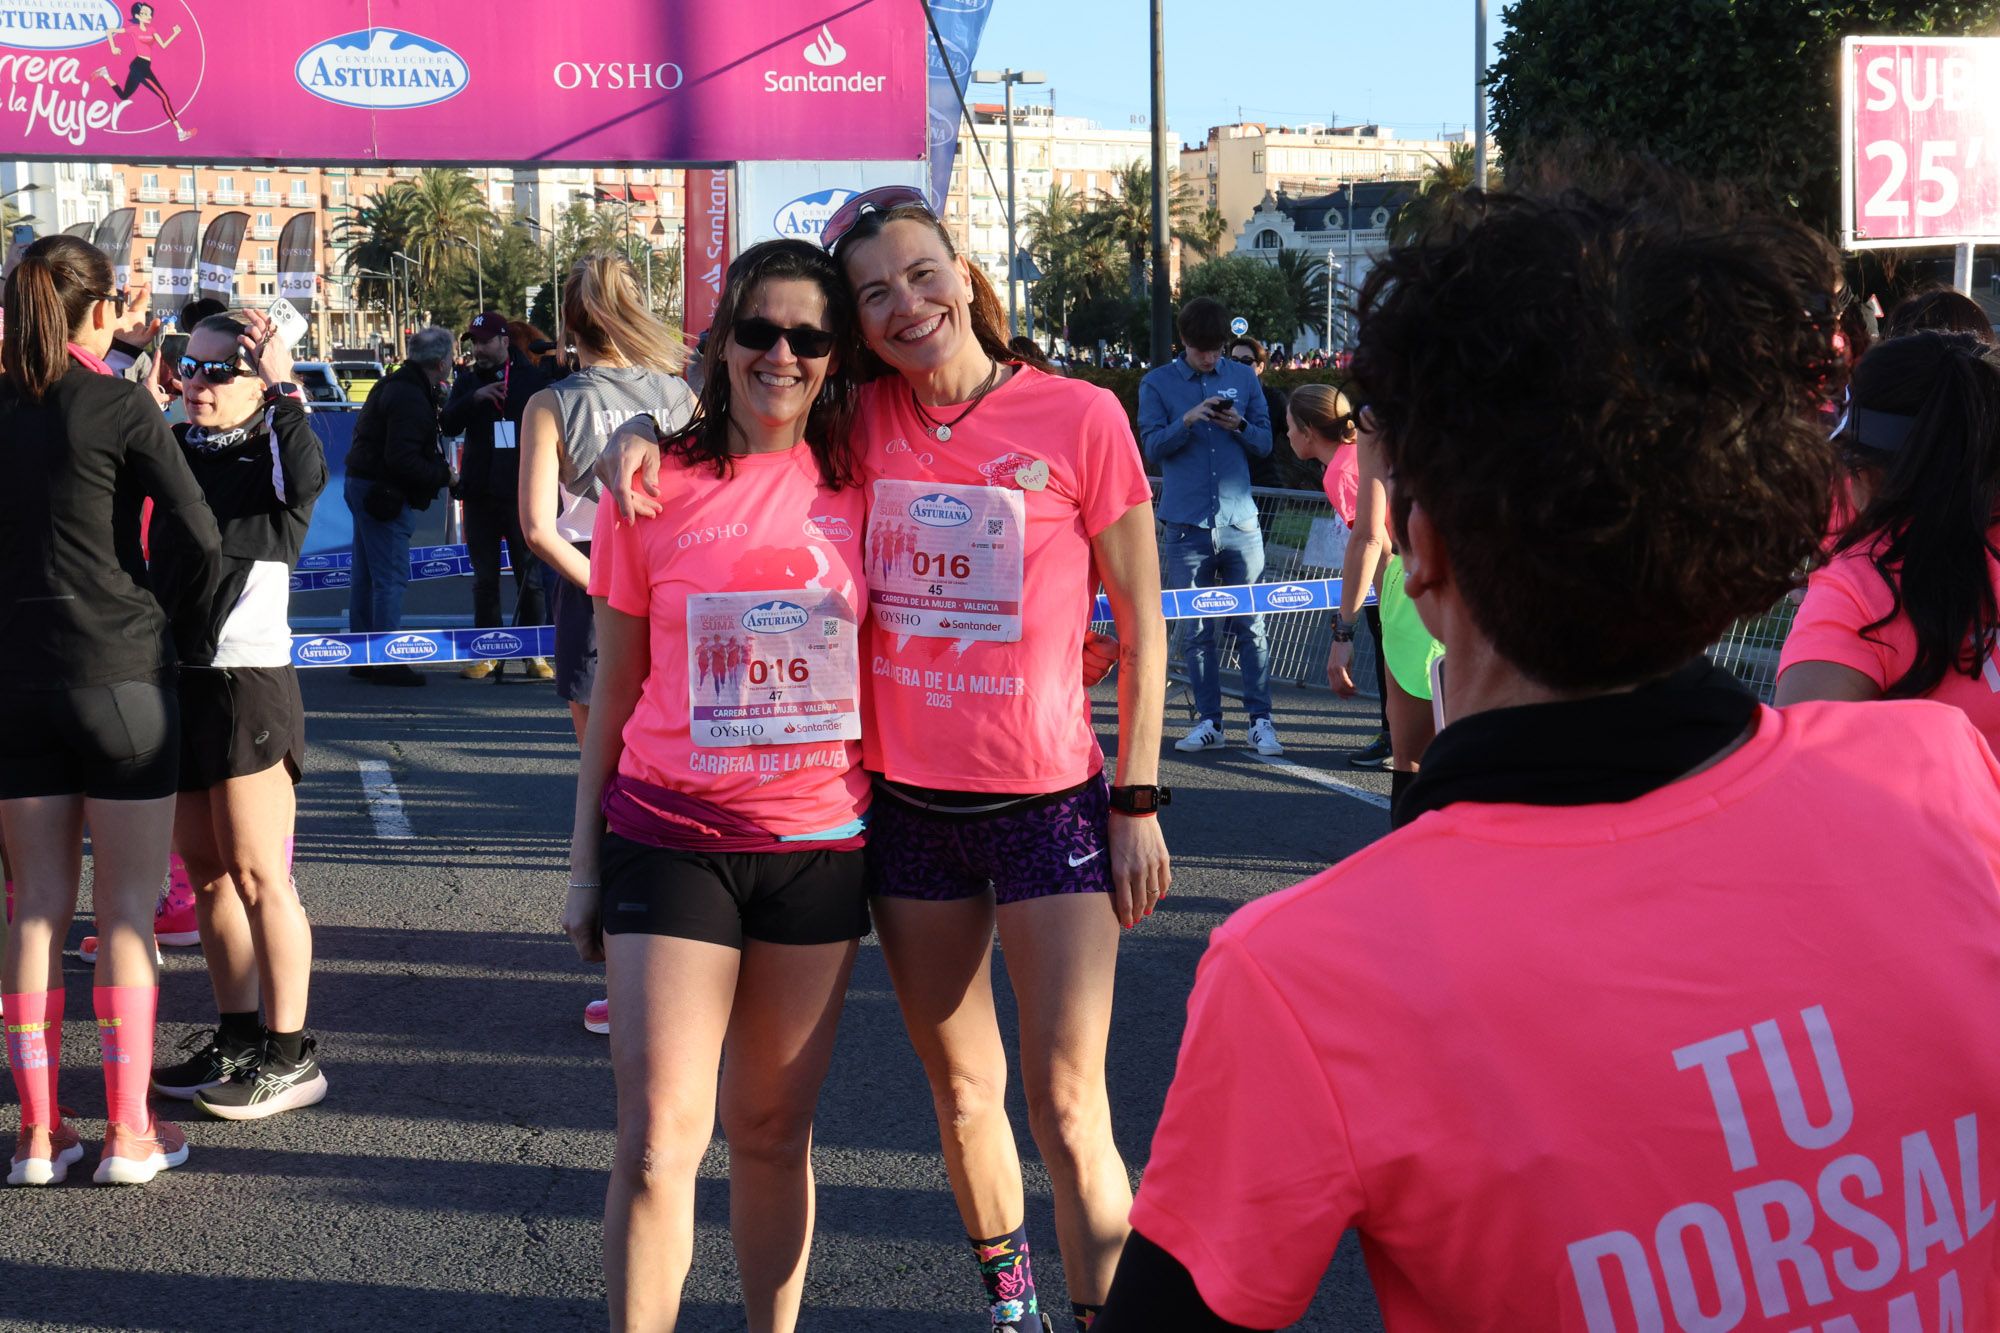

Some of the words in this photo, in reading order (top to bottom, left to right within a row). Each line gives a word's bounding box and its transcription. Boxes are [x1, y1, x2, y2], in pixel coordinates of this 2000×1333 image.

[0, 10, 109, 31] TURIANA
[395, 56, 451, 64] LECHERA
[310, 56, 456, 88] ASTURIANA
[553, 62, 683, 90] OYSHO
[764, 71, 886, 93] Santander
[24, 81, 133, 146] Mujer
[1864, 136, 1984, 218] 25'
[159, 243, 193, 254] OYSHO
[913, 504, 967, 521] ASTURIANA
[678, 523, 748, 549] OYSHO
[912, 551, 971, 579] 016
[928, 584, 943, 595] 45
[881, 594, 908, 605] CARRERA
[910, 598, 919, 606] DE
[920, 599, 930, 607] LA
[931, 600, 957, 609] MUJER
[963, 602, 999, 612] VALENCIA
[1272, 594, 1310, 604] ASTURIANA
[702, 621, 736, 631] SUMA
[747, 614, 804, 627] ASTURIANA
[880, 610, 921, 627] OYSHO
[952, 620, 1003, 632] Santander
[302, 648, 347, 658] ASTURIANA
[388, 645, 434, 655] ASTURIANA
[474, 640, 519, 651] ASTURIANA
[748, 657, 809, 685] 016
[924, 671, 943, 690] DE
[947, 673, 966, 692] LA
[969, 675, 1025, 696] MUJER
[769, 691, 783, 701] 47
[926, 691, 953, 709] 2025
[713, 708, 748, 717] CARRERA
[749, 707, 760, 716] DE
[762, 706, 772, 715] LA
[774, 704, 798, 714] MUJER
[710, 724, 764, 738] OYSHO
[796, 722, 842, 734] Santander
[689, 751, 754, 775] CARRERA
[759, 753, 779, 772] DE
[784, 751, 800, 771] LA
[8, 1020, 51, 1033] GIRLS
[1672, 1004, 1854, 1172] TU
[1566, 1112, 1996, 1333] DORSAL
